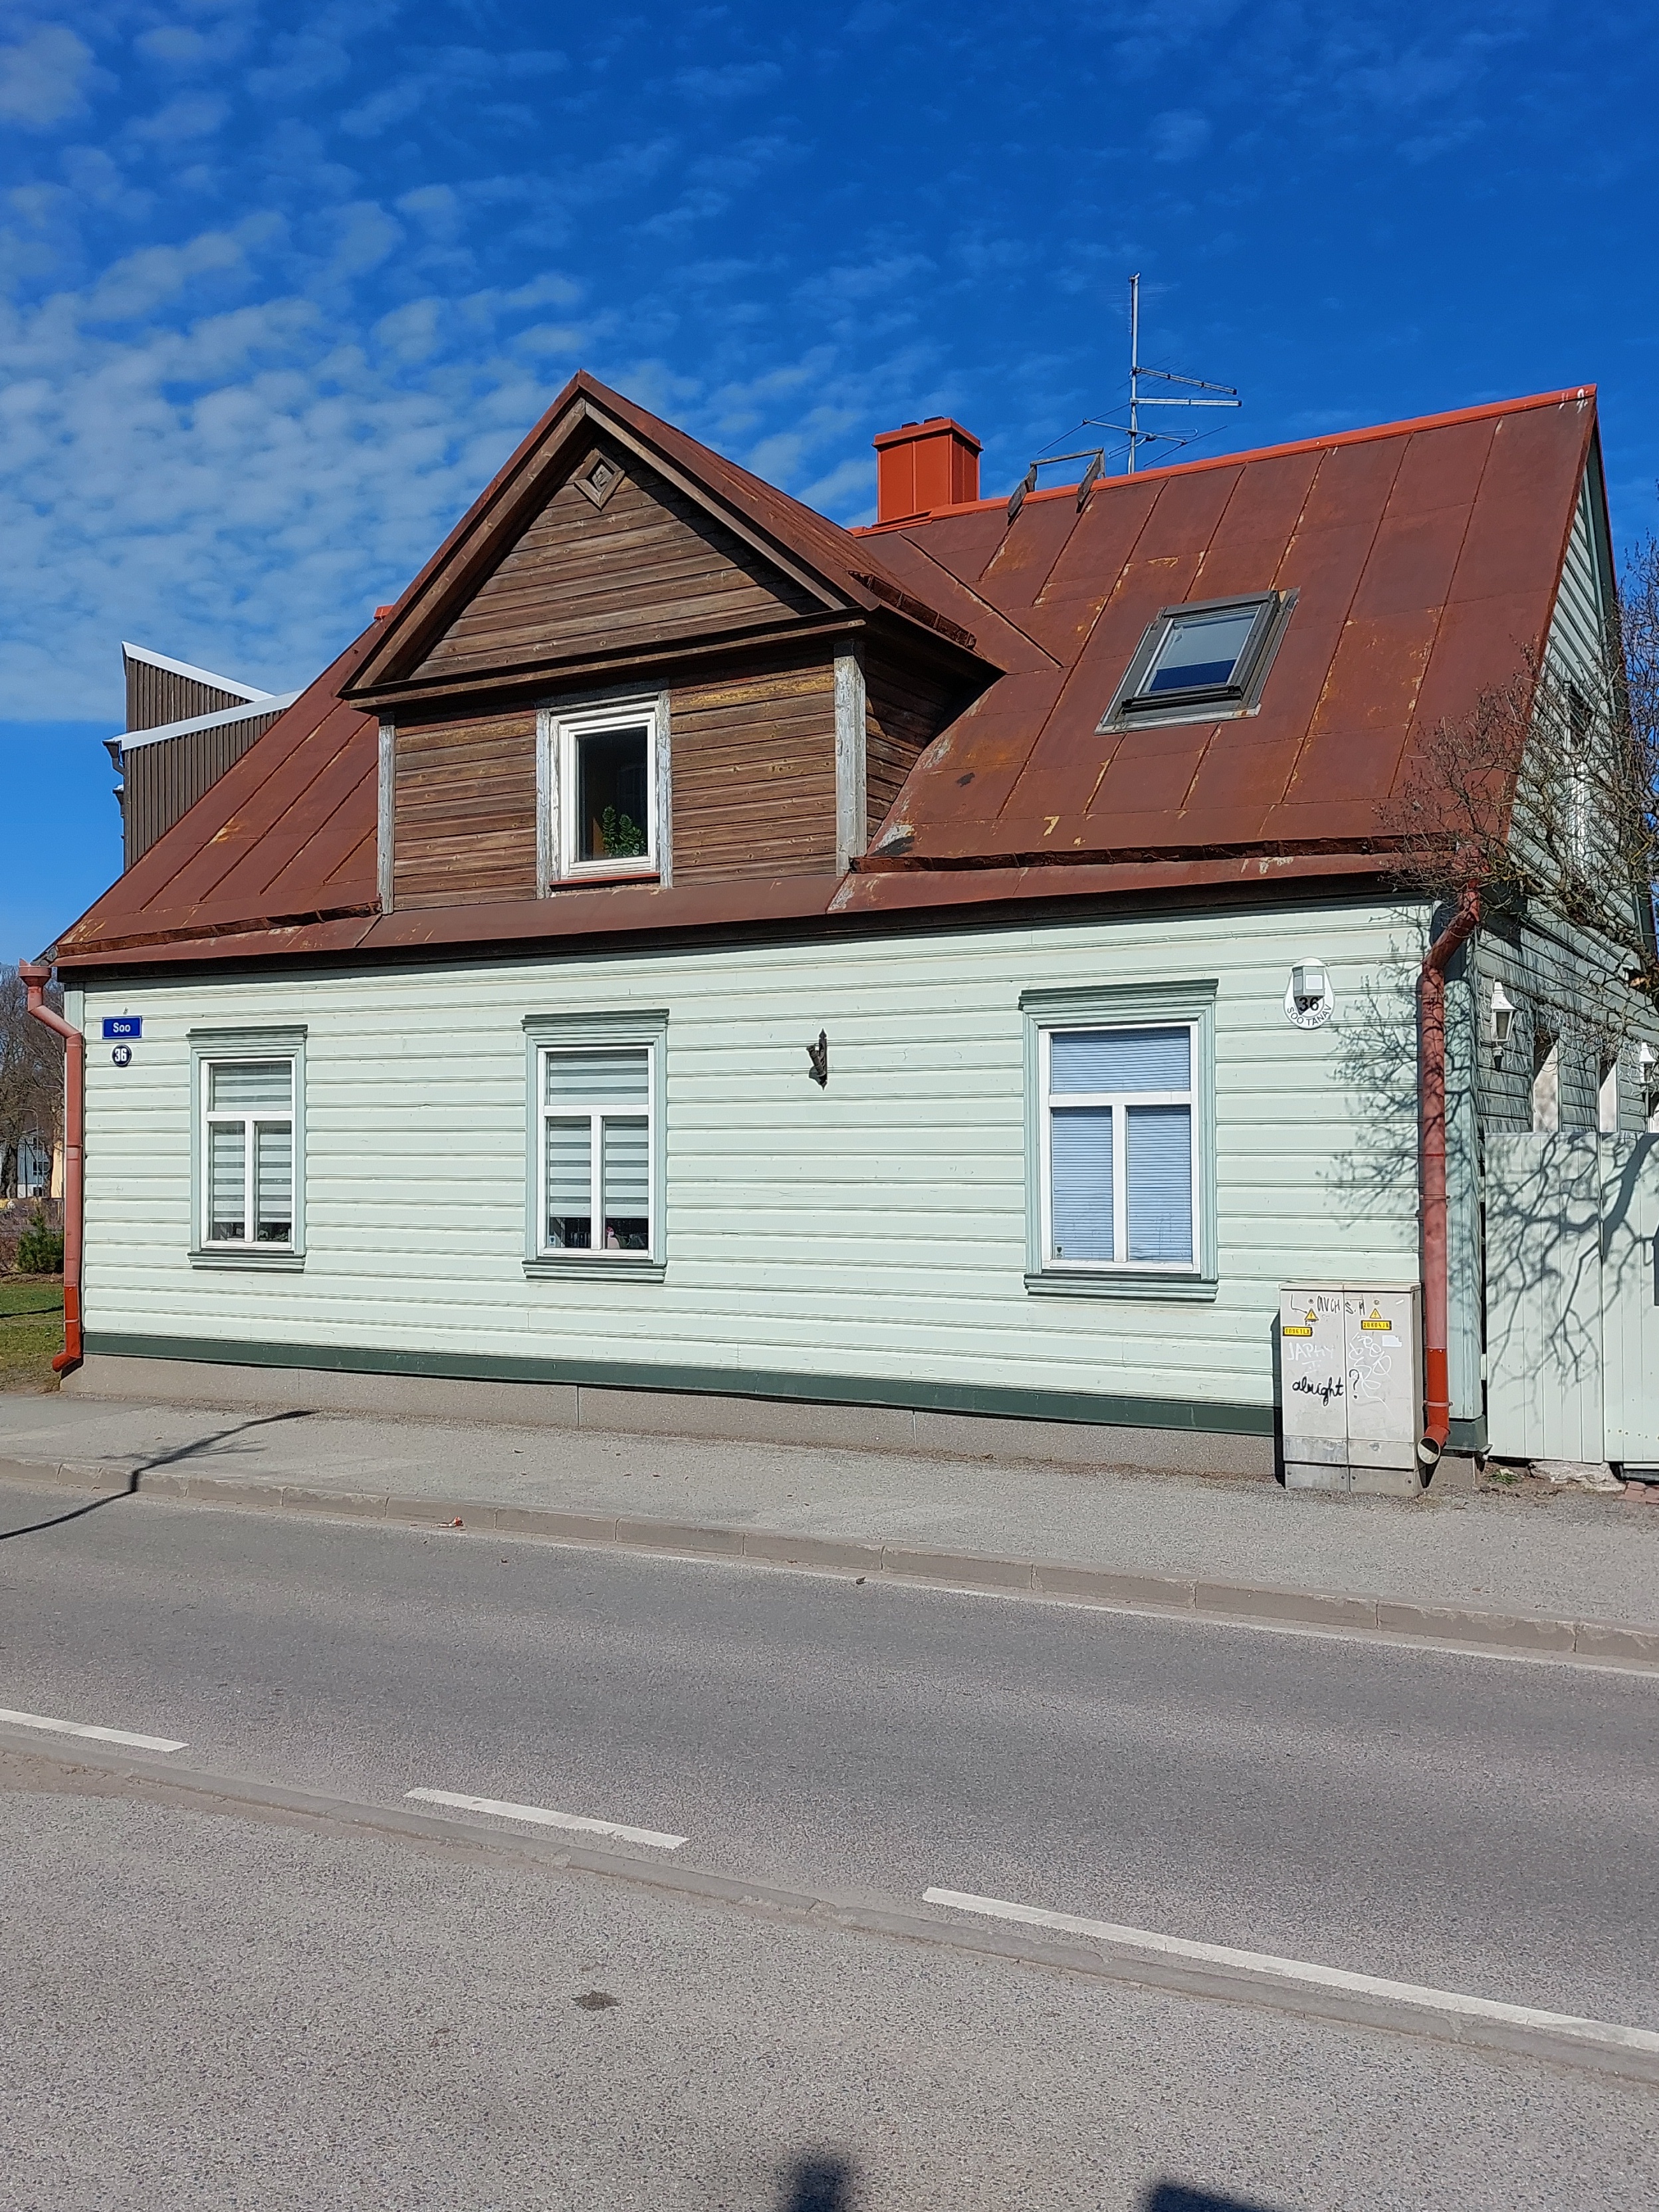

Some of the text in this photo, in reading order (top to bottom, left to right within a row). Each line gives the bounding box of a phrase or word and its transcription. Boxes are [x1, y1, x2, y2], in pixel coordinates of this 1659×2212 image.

[1299, 996, 1319, 1012] 36
[1287, 1006, 1304, 1024] SOO
[112, 1022, 131, 1033] Soo
[114, 1048, 127, 1062] 36
[1292, 1375, 1344, 1407] alright
